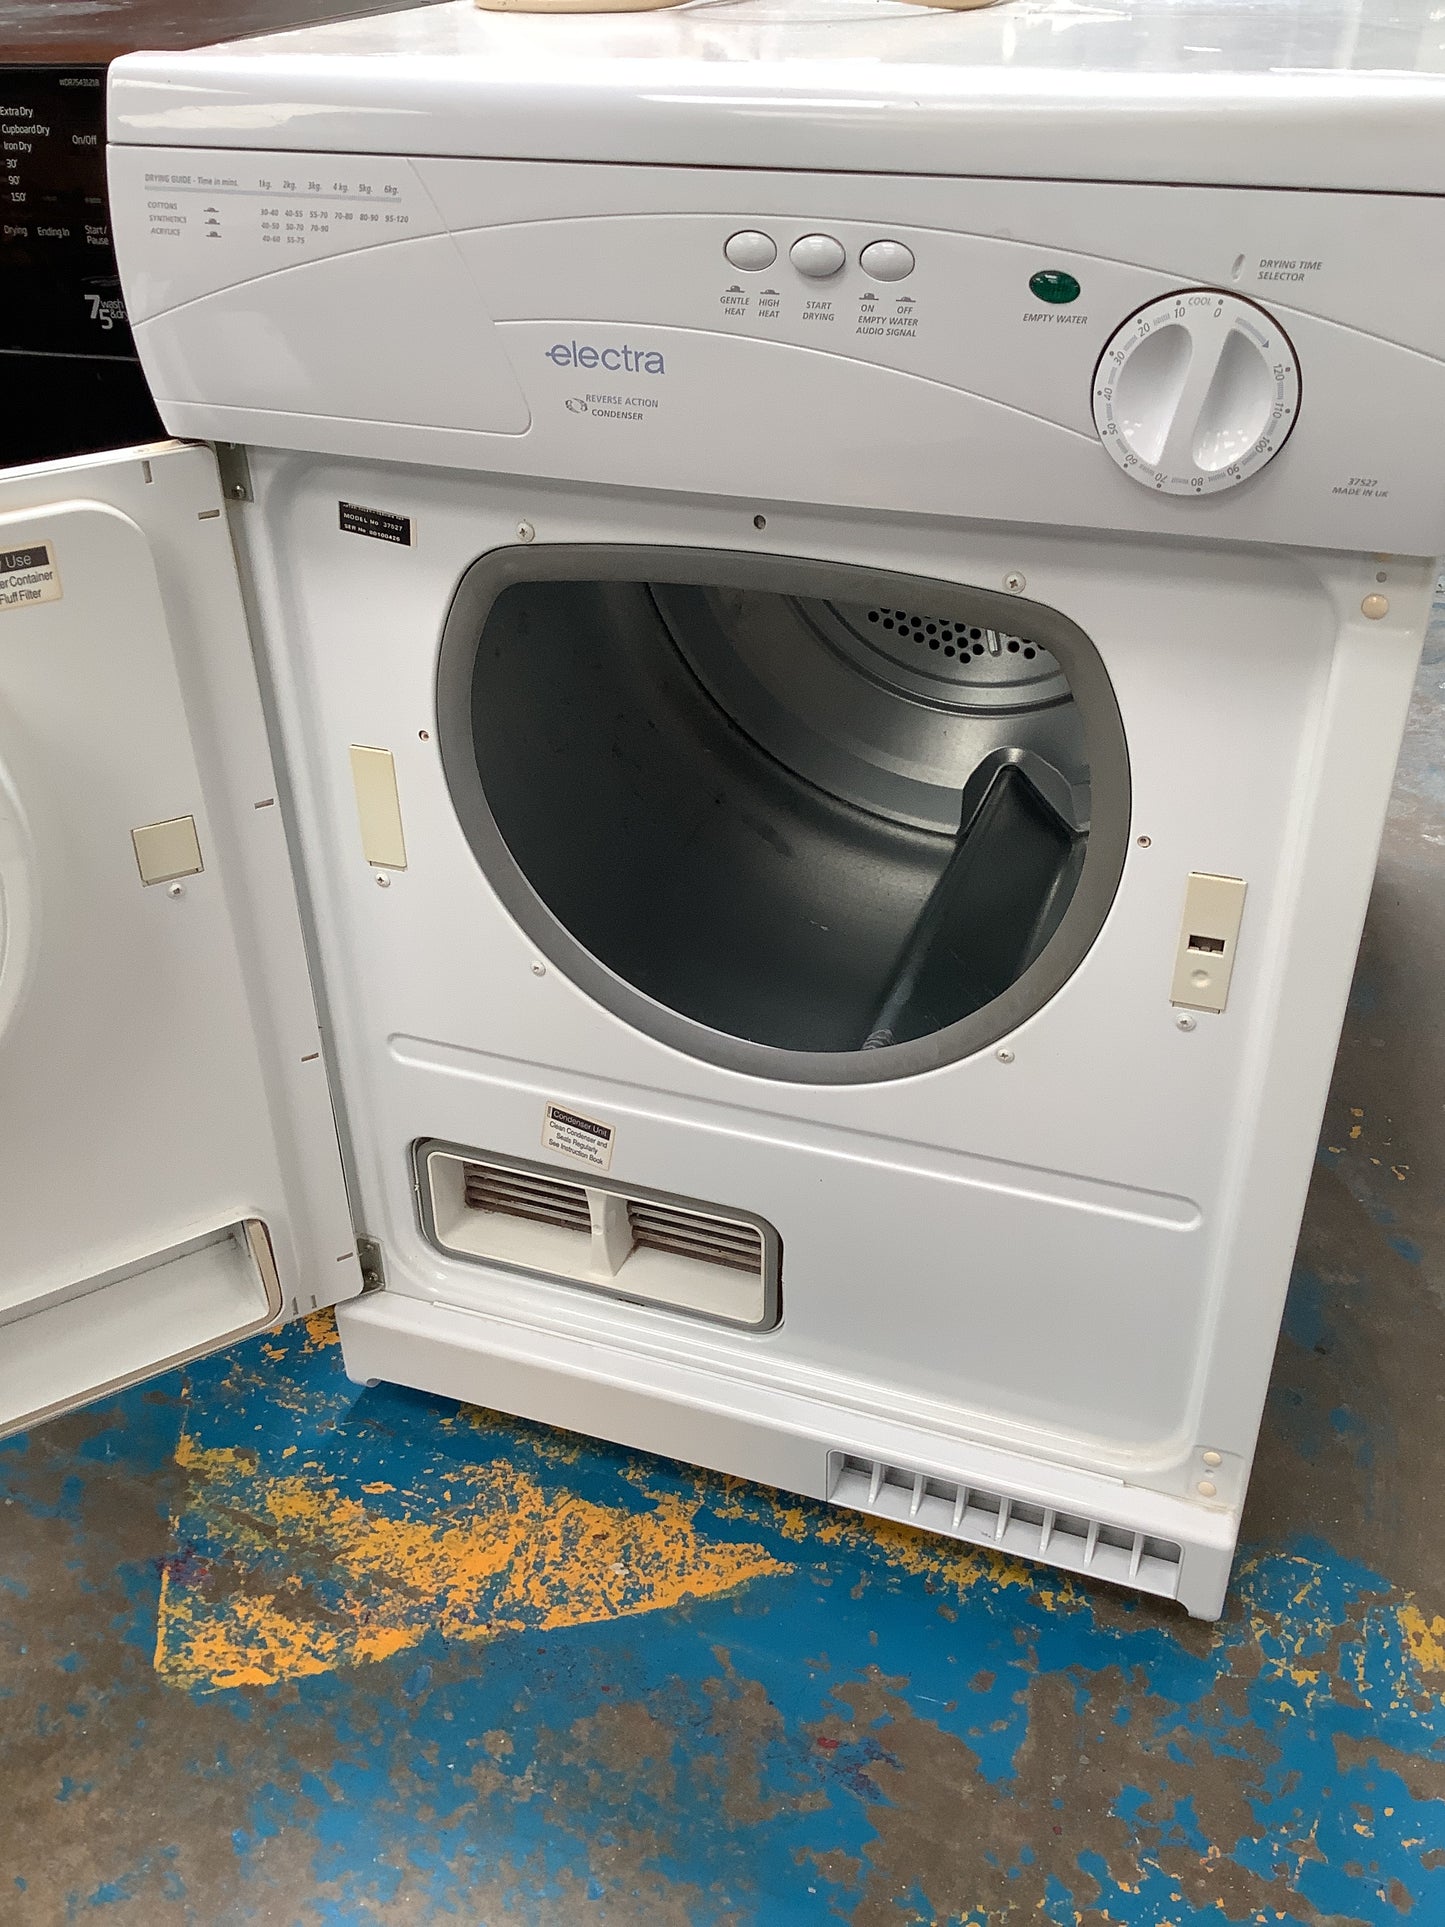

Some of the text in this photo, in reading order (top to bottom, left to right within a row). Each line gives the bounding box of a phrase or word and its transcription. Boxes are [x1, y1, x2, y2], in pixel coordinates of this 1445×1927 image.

[0, 106, 33, 118] Extra Dry
[2, 124, 50, 136] Cupboard Dry
[72, 134, 97, 145] On/Off
[4, 141, 32, 152] Iron Dry
[145, 173, 169, 182] DRYING
[171, 175, 191, 184] GUIDE
[198, 176, 212, 185] Time
[259, 180, 272, 190] 1kg.
[283, 181, 296, 191] 2kg.
[359, 184, 372, 194] 5kg.
[384, 185, 399, 196] 6kg.
[148, 201, 178, 210] COTTONS
[149, 214, 187, 224] SYNTHETICS
[260, 208, 409, 223] 30-40 40-55 55-70 70-80 80-90 95-120
[4, 225, 28, 237] Drying
[37, 226, 62, 239] Ending
[150, 228, 180, 236] ACRYLICS
[261, 222, 329, 232] 40-50 50-70 70-90
[86, 236, 109, 245] Pause
[262, 235, 305, 244] 40-60 55-75
[1260, 260, 1323, 270] DRYING TIME
[1258, 271, 1305, 281] SELECTOR
[84, 294, 100, 319] 7
[100, 298, 124, 309] wash
[720, 296, 750, 306] GENTLE
[759, 298, 780, 307] HIGH
[806, 301, 832, 310] START
[1188, 297, 1212, 306] COOL
[724, 307, 746, 317] HEAT
[861, 304, 875, 312] ON
[897, 306, 914, 315] OFF
[1174, 307, 1185, 318] 10
[1214, 308, 1222, 318] 0
[99, 309, 113, 330] 5
[758, 310, 780, 319] HEAT
[802, 312, 835, 322] DRYING
[1023, 313, 1088, 324] EMPTY WATER
[858, 316, 919, 327] EMPTY WATER
[856, 327, 917, 338] AUDIO SIGNAL
[1138, 322, 1150, 337] 20
[545, 340, 665, 374] electra
[1114, 351, 1125, 366] 30
[1273, 364, 1285, 381] 120
[1104, 387, 1112, 400] 40
[586, 394, 658, 408] REVERSE ACTION
[592, 408, 643, 420] CONDENSER
[1273, 402, 1284, 419] 110
[1107, 423, 1118, 435] 50
[1255, 436, 1270, 453] 100
[1125, 454, 1138, 465] 60
[1227, 464, 1240, 476] 90
[1155, 472, 1168, 483] 70
[1191, 477, 1203, 486] 80
[1348, 478, 1378, 487] 37527
[1332, 487, 1360, 495] MADE
[343, 513, 368, 523] MODEL
[383, 522, 403, 531] 37527
[5, 555, 31, 568] Use
[10, 571, 52, 587] Container
[19, 589, 41, 600] Filter
[554, 1110, 591, 1130] Condenser
[593, 1125, 607, 1136] Unit
[550, 1121, 608, 1148] Clean Condenser and
[556, 1133, 598, 1155] Seals Regularly
[549, 1139, 603, 1165] See Instruction Book
